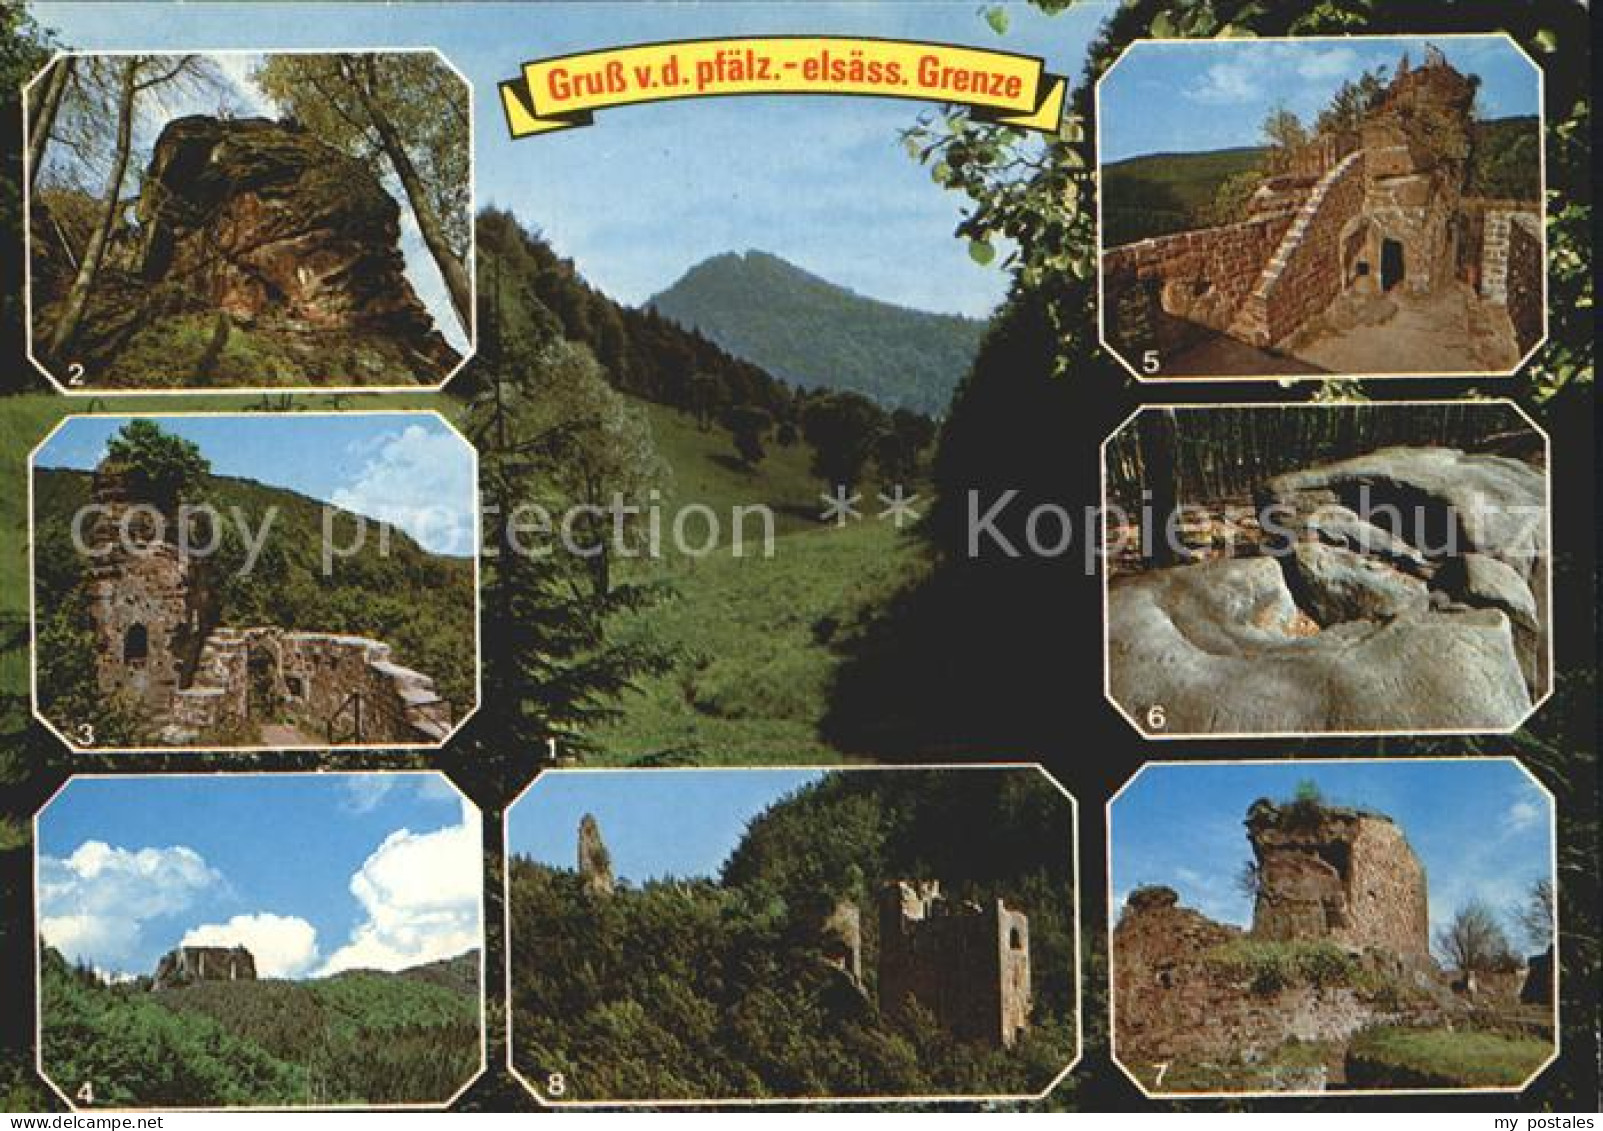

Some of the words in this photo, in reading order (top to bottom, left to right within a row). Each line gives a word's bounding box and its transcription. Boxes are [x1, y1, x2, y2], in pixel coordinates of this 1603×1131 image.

[548, 61, 627, 101] Gruß
[917, 54, 1022, 99] Grenze
[1144, 350, 1160, 371] 5
[69, 364, 84, 386] 2
[1147, 705, 1166, 728] 6
[77, 723, 94, 745] 3
[546, 738, 556, 758] 1
[547, 1071, 566, 1096] 8
[1153, 1062, 1169, 1086] 7
[77, 1081, 94, 1103] 4
